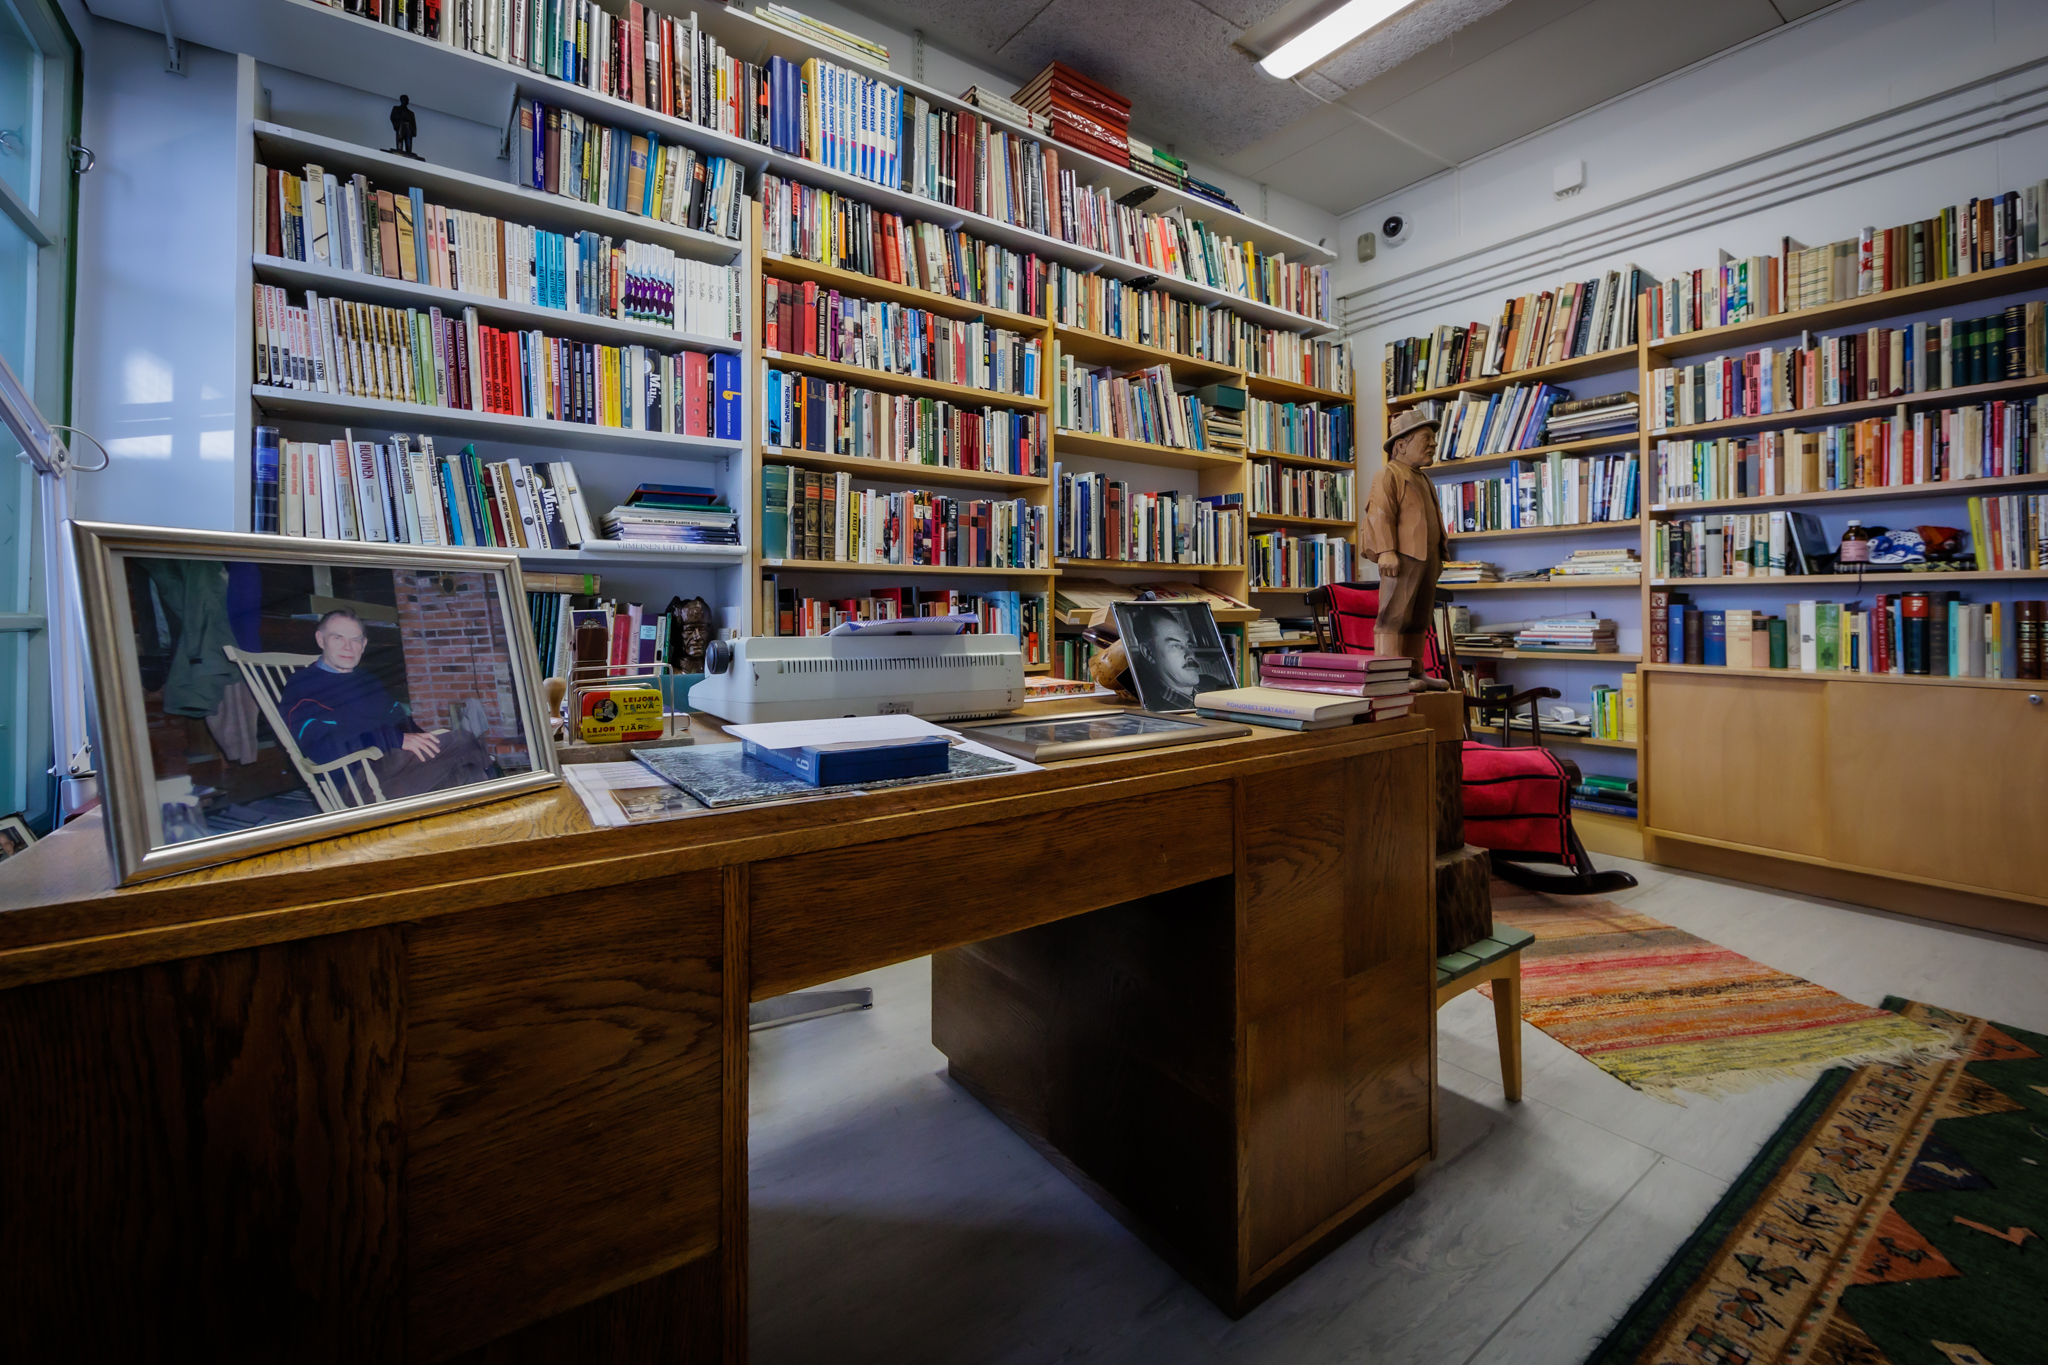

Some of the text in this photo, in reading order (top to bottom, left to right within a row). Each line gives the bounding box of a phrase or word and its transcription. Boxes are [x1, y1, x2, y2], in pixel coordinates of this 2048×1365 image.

[800, 27, 812, 36] ARK
[813, 32, 826, 43] VAN
[826, 37, 847, 51] NOACH
[918, 103, 926, 125] SUOMI
[266, 287, 274, 304] VEIKKO
[539, 266, 547, 302] TALVITURISTI
[557, 270, 565, 305] TALVITURISTI
[256, 302, 264, 327] HUOVINEN
[309, 308, 325, 380] VEIKKO HUOVINEN LENTSU
[432, 309, 445, 395] VEIKKO HUOVINEN Lohkaisuja
[447, 338, 455, 366] HUOVINEN
[458, 342, 467, 368] HUOVINEN
[1465, 338, 1477, 368] GAUGUIN
[334, 442, 349, 478] HUOVINEN
[427, 443, 437, 466] Aikamme
[359, 444, 379, 538] HUOVINEN 2
[401, 468, 413, 495] saloilla
[525, 467, 533, 479] ARTO
[532, 499, 541, 514] AJATUS
[537, 521, 548, 549] HIIRIHAUKKA
[500, 497, 509, 511] AJATUS
[506, 519, 516, 547] HIIRIHAUKKA
[616, 542, 662, 551] VIIMEINEN
[1877, 596, 1884, 606] EN
[1878, 623, 1885, 634] OM
[623, 695, 660, 703] LEIJONA
[1225, 701, 1296, 716] POHJOISET ERÄTARINAT
[587, 723, 643, 734] LEJON TJÄR
